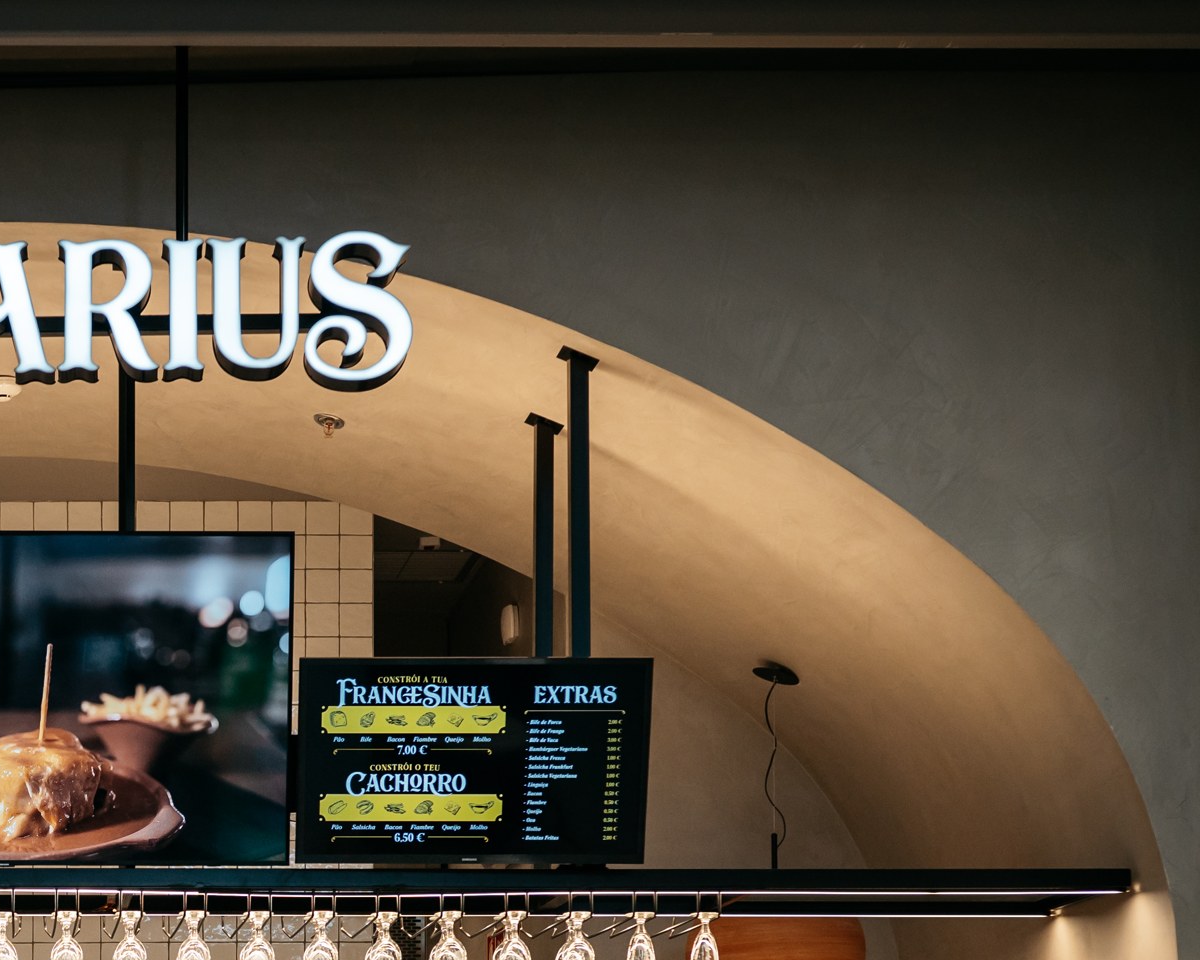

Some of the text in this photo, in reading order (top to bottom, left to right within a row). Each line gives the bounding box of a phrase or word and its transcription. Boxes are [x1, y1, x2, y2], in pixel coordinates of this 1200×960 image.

[378, 674, 420, 683] CONSTRÓI
[336, 678, 492, 708] FRANCESINHA
[534, 685, 618, 704] EXTRAS
[397, 745, 428, 755] 7.00 €
[370, 762, 412, 772] CONSTRÓI
[346, 771, 467, 796] CACHORRO
[394, 833, 425, 843] 6.50 €
